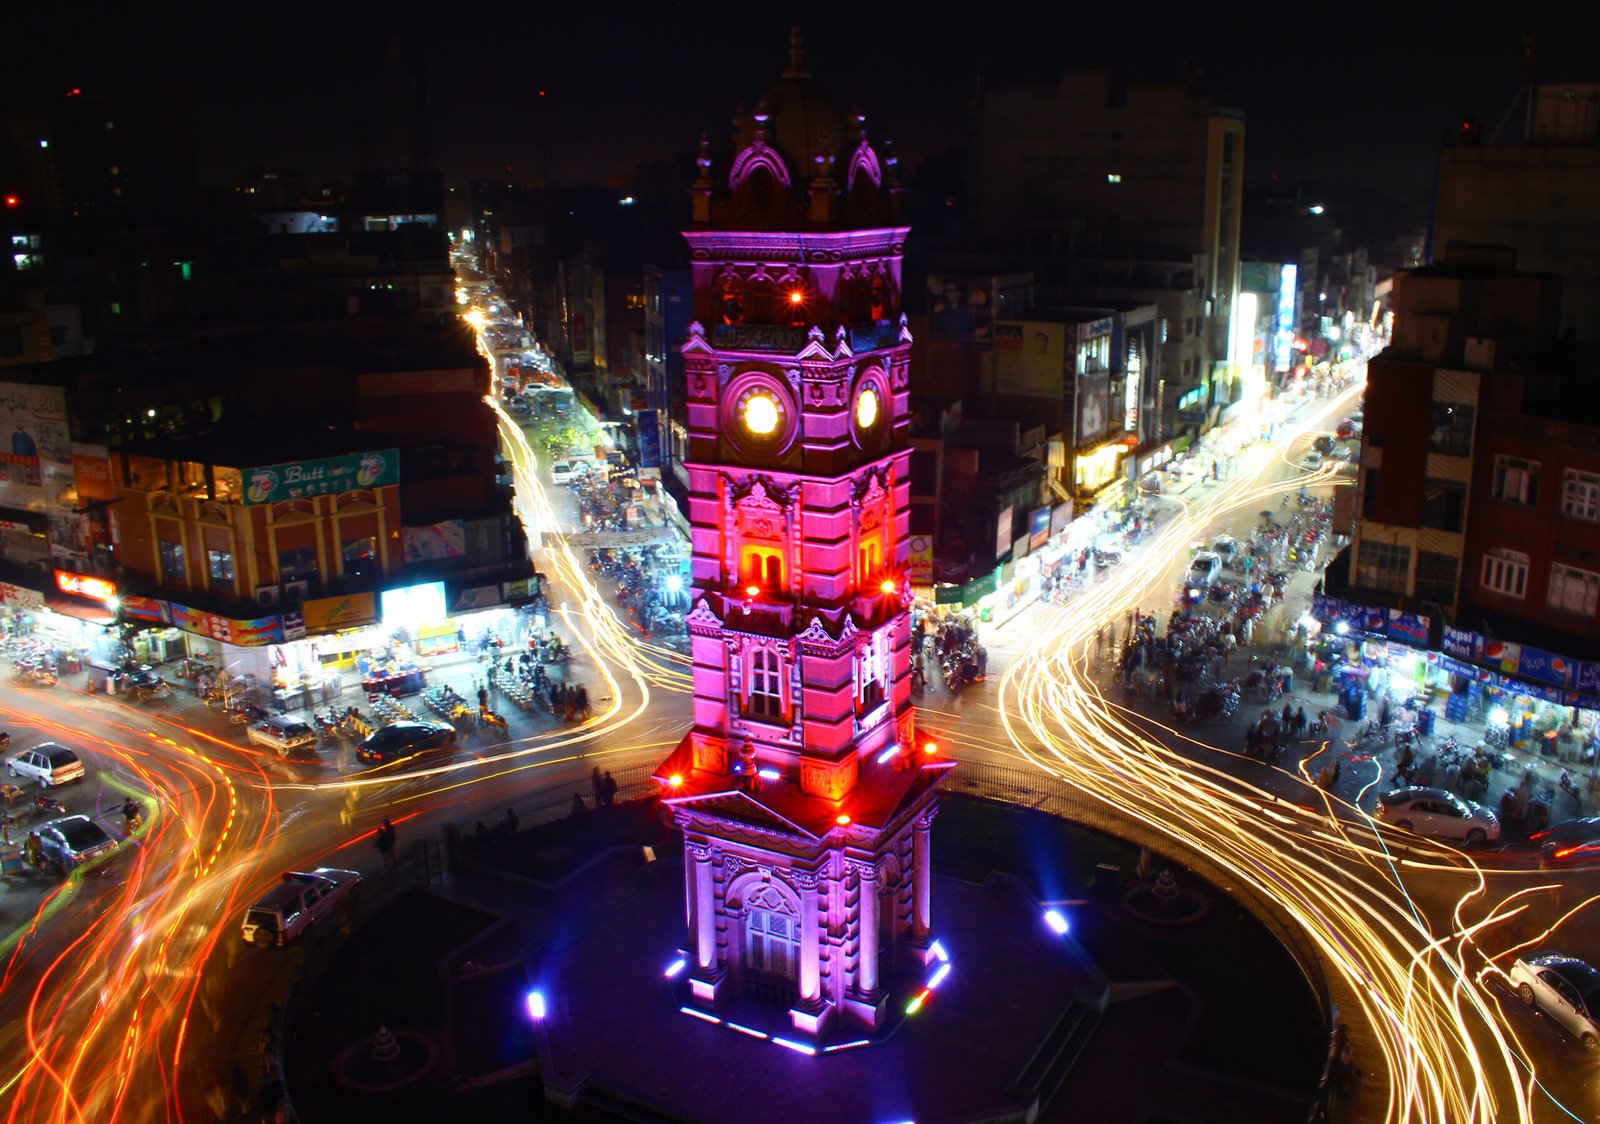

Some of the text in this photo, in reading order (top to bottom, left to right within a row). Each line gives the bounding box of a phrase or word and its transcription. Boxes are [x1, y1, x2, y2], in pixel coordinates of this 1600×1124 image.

[282, 466, 325, 484] Butt
[1444, 625, 1473, 643] Pepsi
[1443, 638, 1471, 657] Point
